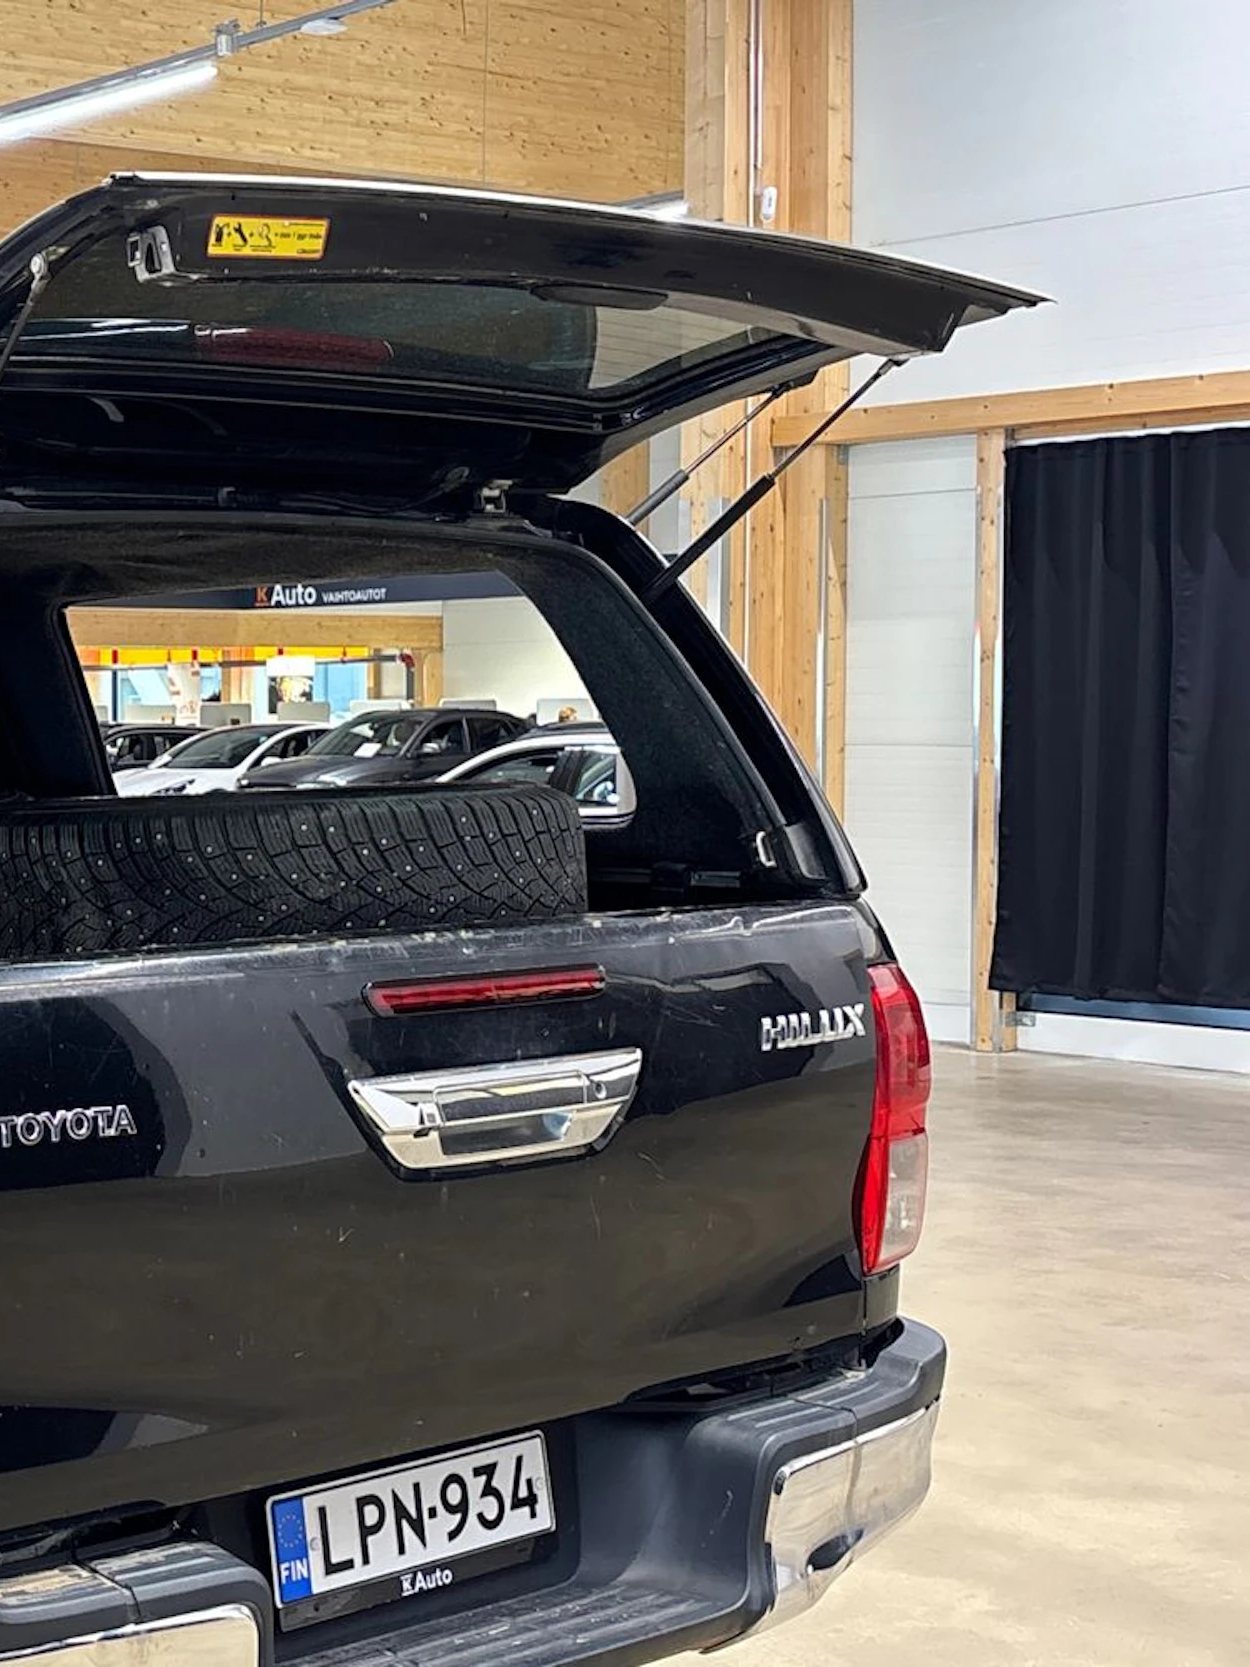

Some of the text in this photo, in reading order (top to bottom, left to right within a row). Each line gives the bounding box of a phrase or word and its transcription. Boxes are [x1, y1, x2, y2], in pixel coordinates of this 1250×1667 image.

[321, 587, 387, 603] VAIHTOAUTOT
[760, 1002, 866, 1051] HILUX
[279, 1558, 309, 1585] FIN
